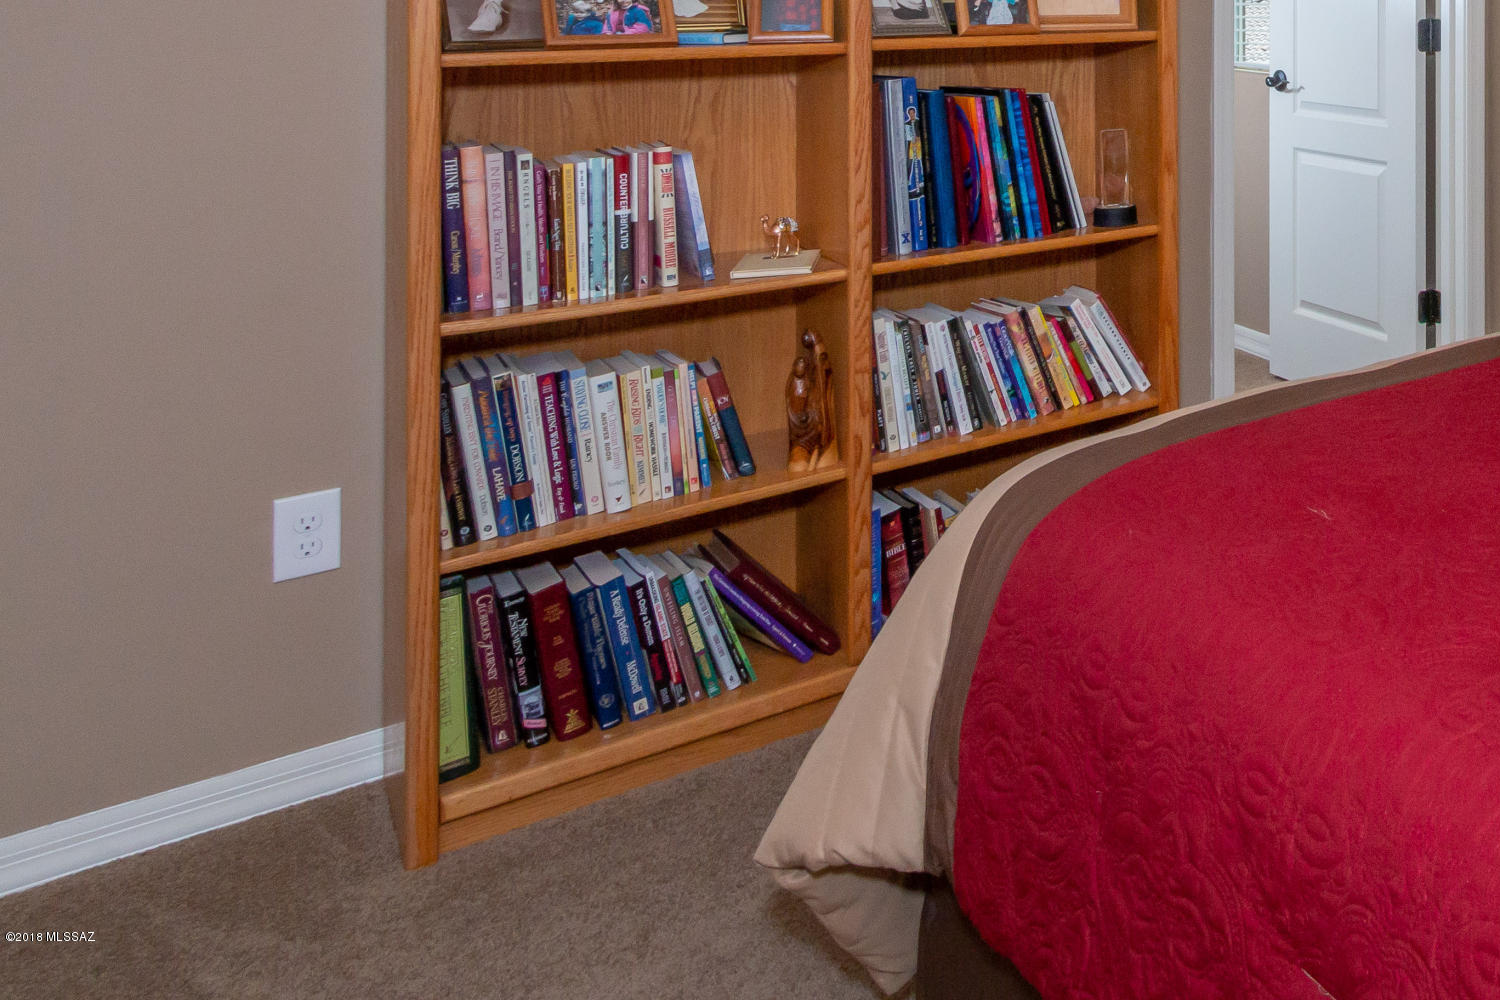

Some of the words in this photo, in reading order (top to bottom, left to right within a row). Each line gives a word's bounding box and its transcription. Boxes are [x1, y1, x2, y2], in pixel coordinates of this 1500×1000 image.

[444, 157, 458, 189] THINK
[446, 191, 459, 210] BIG
[619, 173, 628, 210] COUNTER
[620, 212, 628, 248] CULTURE
[663, 207, 674, 239] RUSSELL
[664, 240, 676, 268] MOORE
[573, 378, 587, 408] STAYING
[628, 379, 639, 406] RAISING
[544, 393, 556, 431] TEACHING
[577, 408, 590, 432] CLOSE
[631, 407, 641, 425] KIDS
[584, 438, 592, 462] Rainey
[633, 434, 644, 456] RIGHT
[510, 444, 524, 481] DOBSON
[885, 543, 906, 558] BIBLE
[610, 589, 620, 597] A
[611, 596, 623, 617] Ready
[638, 598, 647, 615] Only
[616, 617, 628, 644] Defense
[626, 660, 641, 694] McDowell
[487, 687, 501, 725] STANLEY
